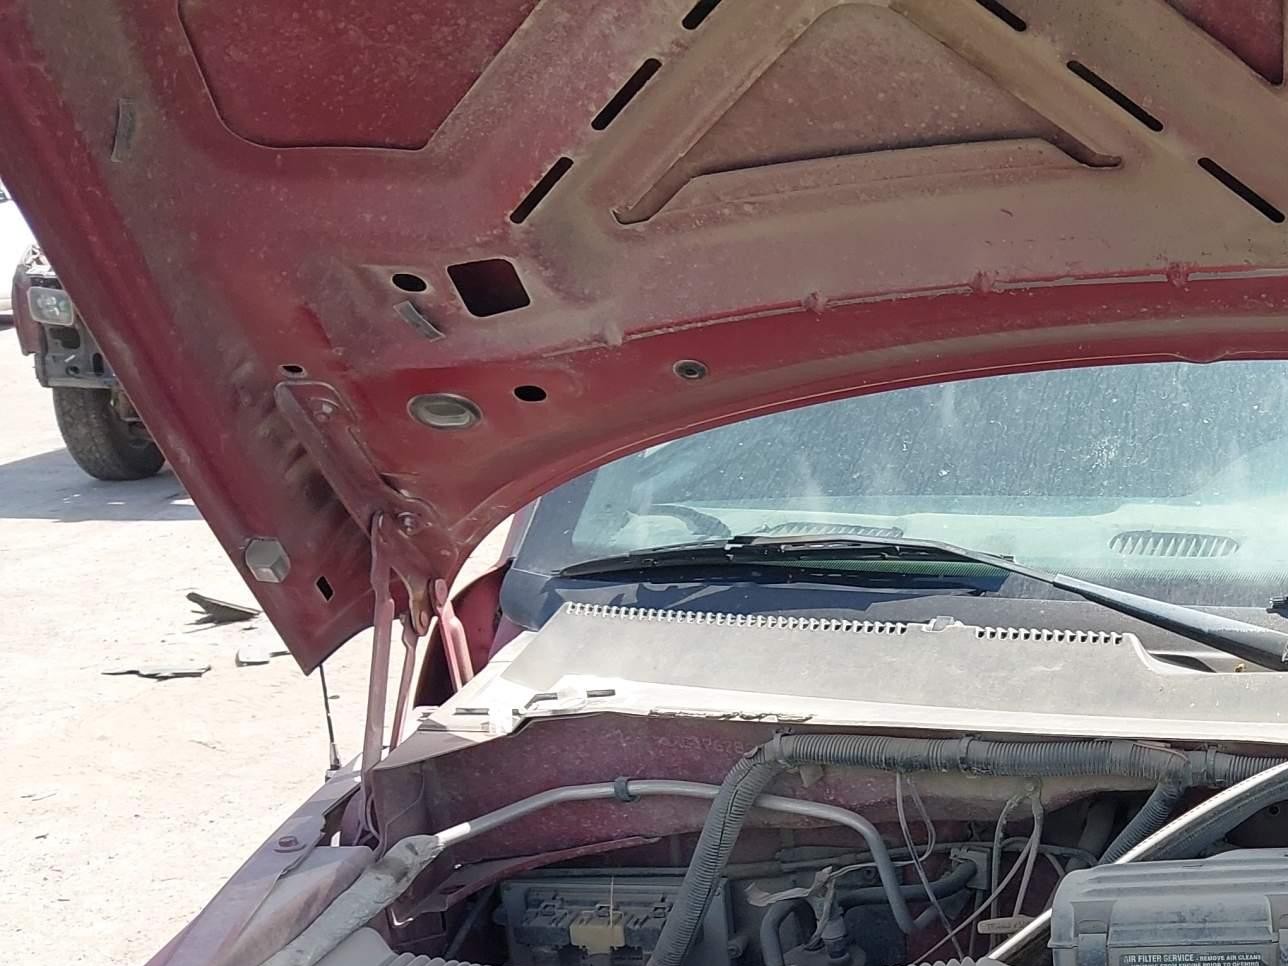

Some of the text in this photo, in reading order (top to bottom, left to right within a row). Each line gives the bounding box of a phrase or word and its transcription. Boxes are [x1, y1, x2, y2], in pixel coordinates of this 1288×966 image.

[1123, 954, 1136, 963] AIR
[1138, 954, 1162, 963] FILTER
[1163, 953, 1195, 962] SERVICE
